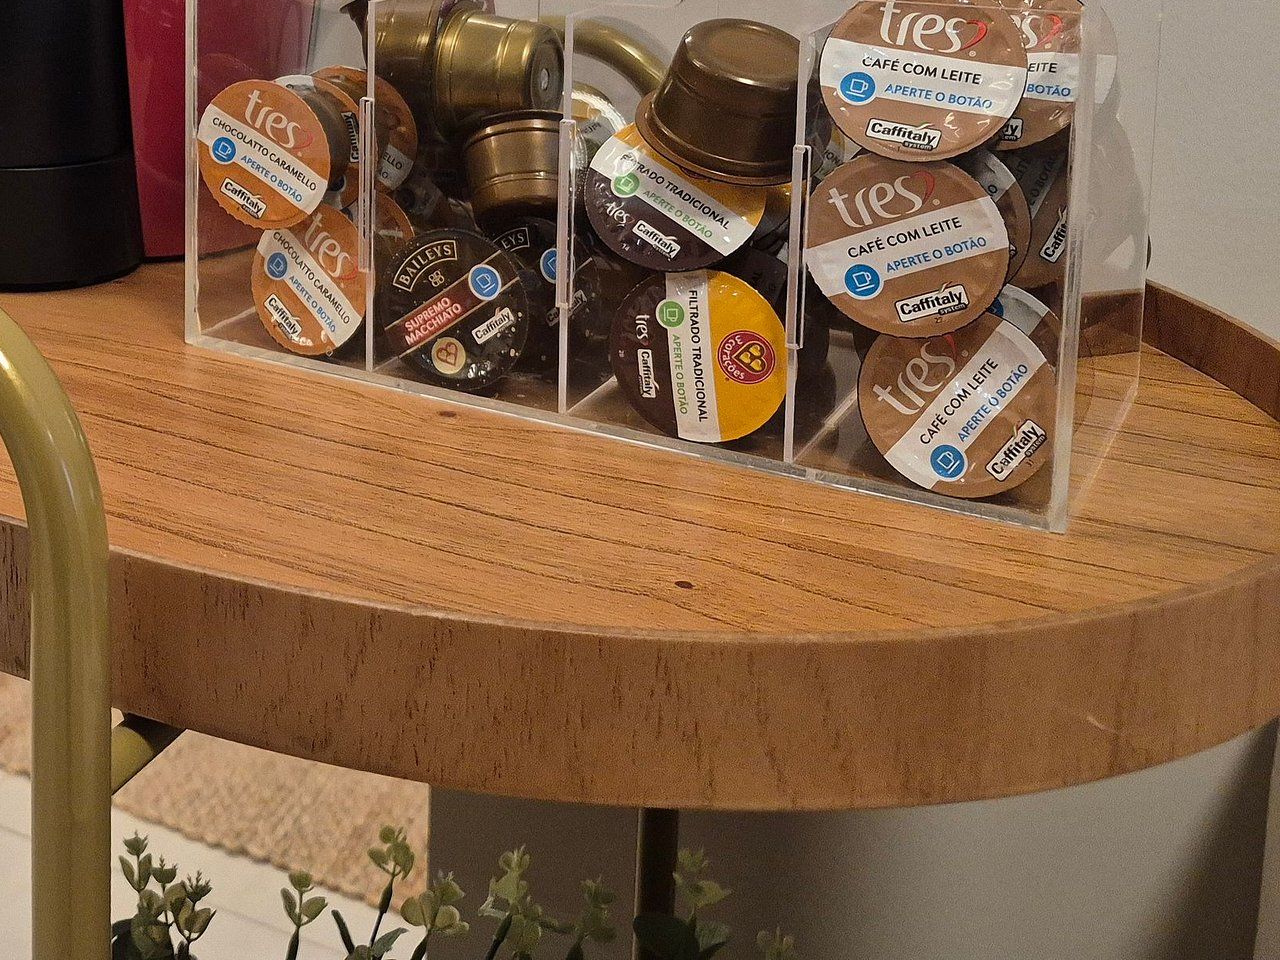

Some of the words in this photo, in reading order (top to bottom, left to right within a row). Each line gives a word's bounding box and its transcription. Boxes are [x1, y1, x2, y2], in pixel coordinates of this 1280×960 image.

[862, 56, 900, 72] CAFÉ
[902, 64, 938, 80] COM
[941, 68, 982, 85] LEITE
[1028, 62, 1058, 73] EITE
[884, 83, 931, 101] APERTE
[934, 90, 946, 102] O
[948, 93, 993, 110] BOTÃO
[1026, 83, 1071, 97] BOTÃO
[245, 89, 302, 149] tres
[870, 122, 938, 145] Caffitaly
[211, 116, 269, 157] CHOCOLATTO
[269, 152, 317, 192] CARAMELLO
[224, 181, 263, 214] Caffitaly
[240, 154, 271, 179] APERTE
[270, 174, 278, 183] O
[277, 178, 303, 203] BOTÃO
[642, 190, 673, 214] APERTE
[674, 209, 683, 219] O
[682, 212, 713, 239] BOTÃO
[667, 180, 729, 230] TRADICIONAL
[828, 175, 923, 229] tres
[304, 211, 354, 278] tres
[636, 223, 677, 255] Caffitaly
[847, 236, 885, 259] CAFÉ
[886, 229, 920, 248] COM
[923, 216, 963, 238] LEITE
[885, 252, 931, 274] APERTE
[931, 248, 943, 260] O
[944, 236, 987, 257] BOTÃO
[273, 231, 315, 281] CHOCOLATTO
[313, 279, 351, 325] CARAMELLO
[399, 243, 453, 286] BAILEYS
[268, 297, 300, 335] Caffitaly
[288, 275, 312, 303] APERTE
[311, 300, 318, 309] O
[316, 306, 337, 333] BOTÃO
[404, 296, 452, 332] SUPREMO
[688, 290, 702, 344] FILTRADO
[899, 289, 964, 316] Caffitaly
[404, 303, 463, 346] MACCHIATO
[474, 311, 513, 341] Caffitaly
[635, 314, 651, 341] tres
[640, 350, 654, 396] Caffitaly
[672, 334, 683, 371] APERTE
[675, 372, 684, 381] O
[676, 381, 690, 415] BOTÃO
[691, 346, 709, 423] TRADICIONAL
[872, 341, 956, 416] tres
[920, 413, 948, 445] CAFÉ
[943, 388, 972, 417] COM
[967, 357, 999, 391] LEITE
[958, 403, 991, 443] APERTE
[989, 396, 999, 407] O
[997, 363, 1028, 399] BOTÃO
[991, 425, 1041, 475] Caffitaly
